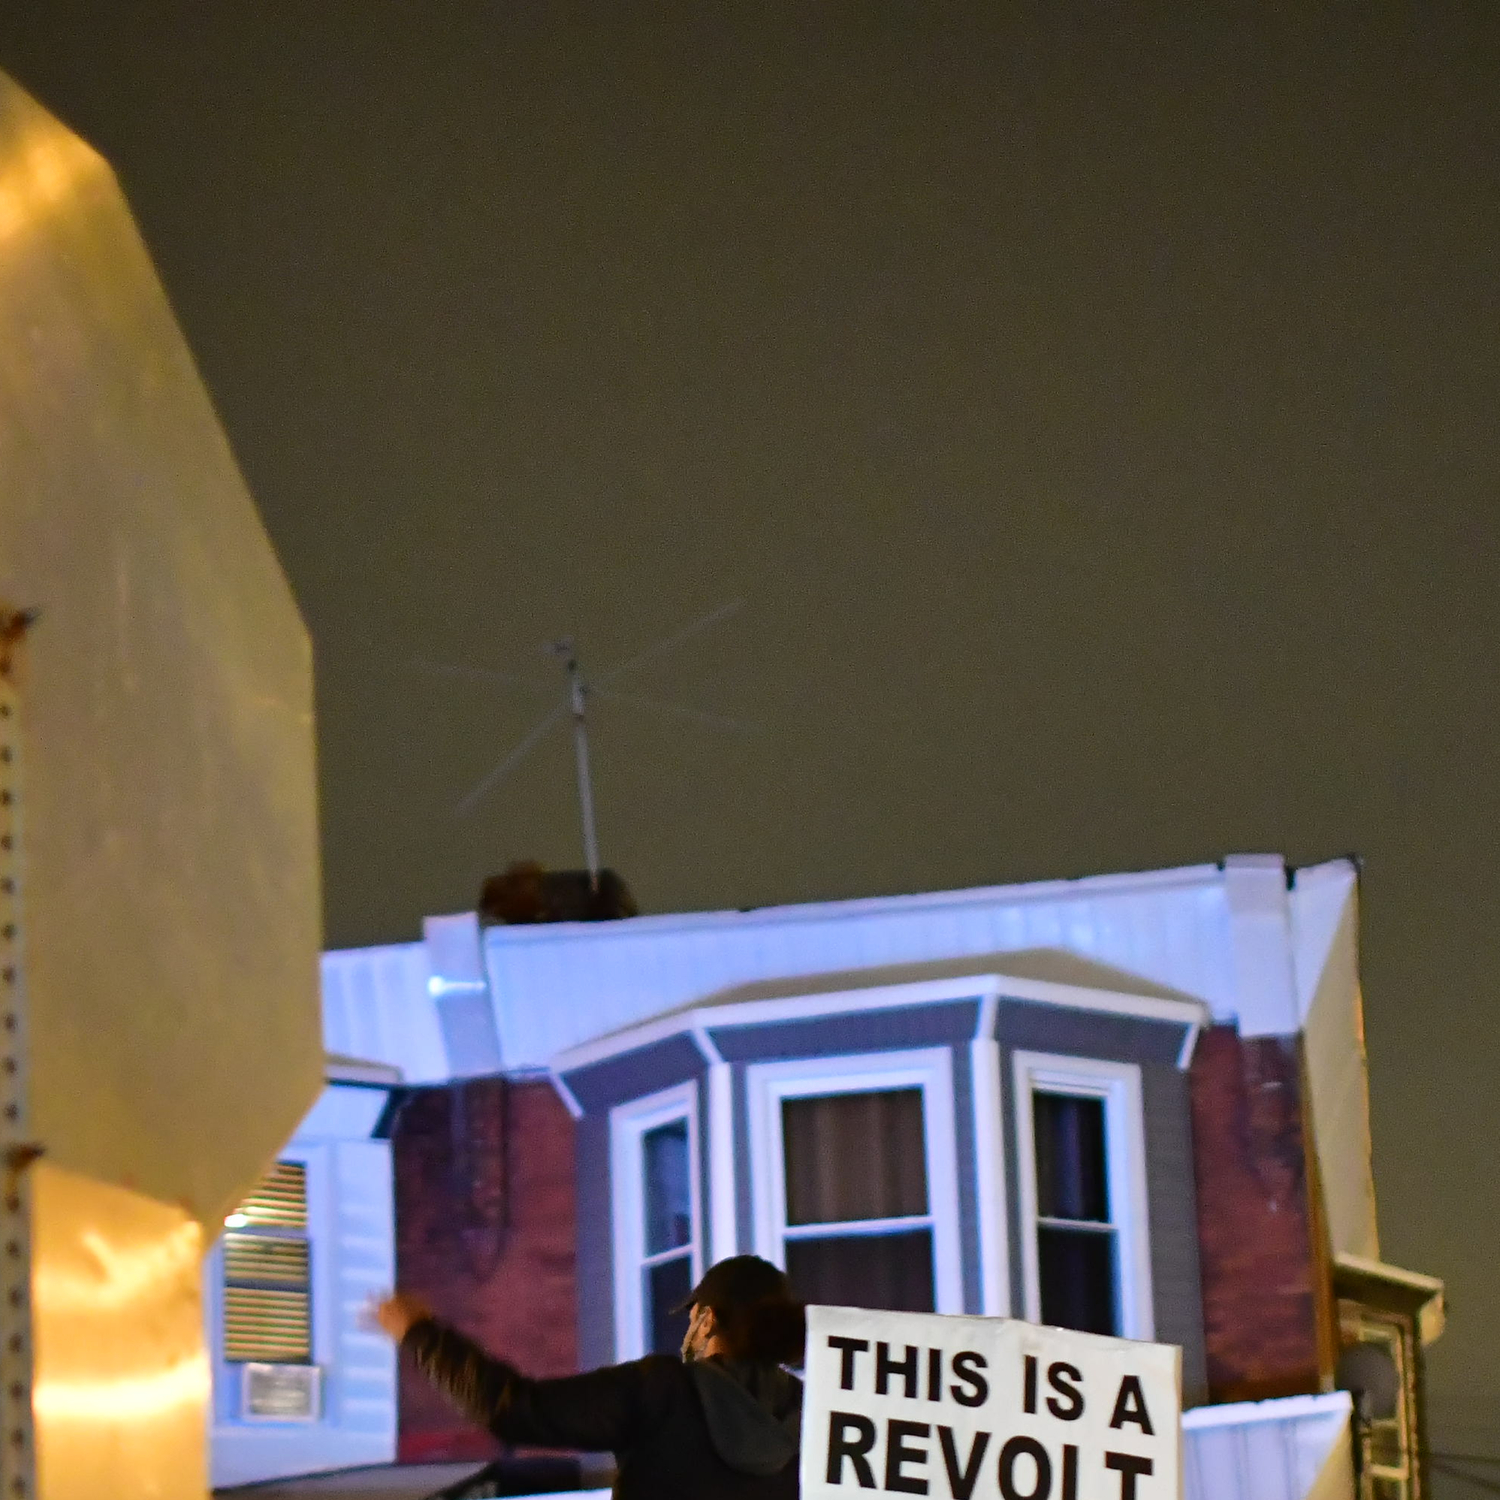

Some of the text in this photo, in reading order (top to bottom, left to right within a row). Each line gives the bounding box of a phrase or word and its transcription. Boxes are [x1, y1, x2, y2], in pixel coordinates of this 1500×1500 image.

[828, 1335, 1156, 1435] THIS IS A
